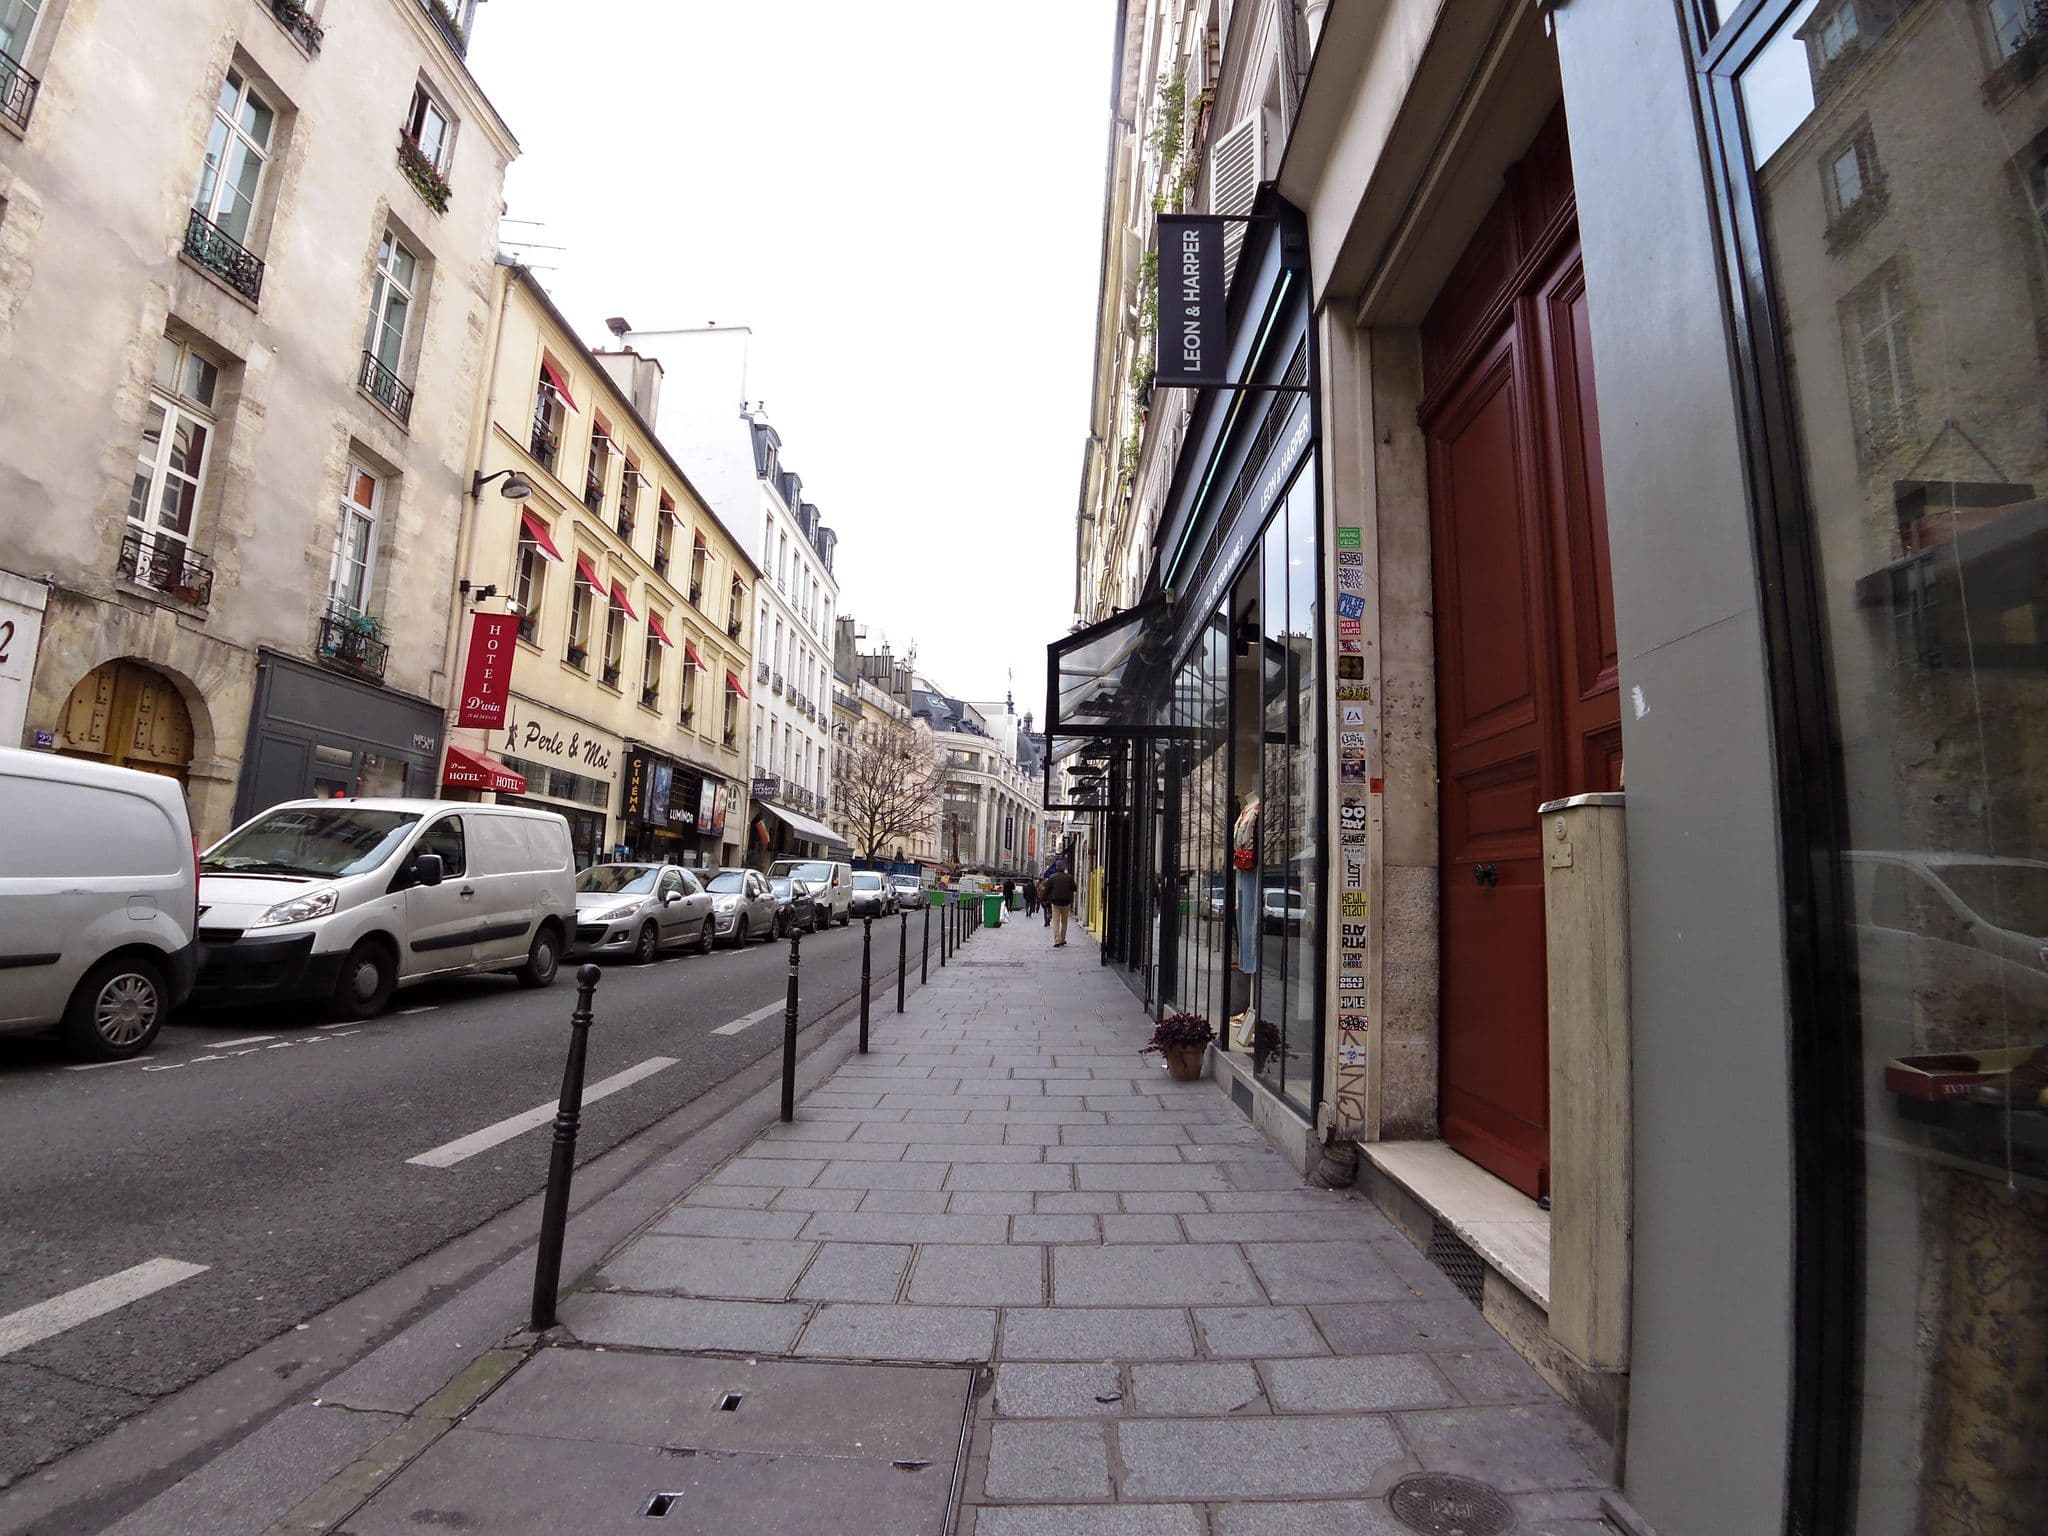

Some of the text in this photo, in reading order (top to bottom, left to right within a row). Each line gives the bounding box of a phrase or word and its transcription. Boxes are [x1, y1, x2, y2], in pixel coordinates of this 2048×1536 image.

[1183, 229, 1201, 372] LEON & HARPER
[1260, 472, 1277, 514] LEON
[1281, 413, 1309, 476] HARPER
[481, 624, 502, 694] HOTEL
[38, 733, 52, 746] 22
[523, 721, 563, 756] Perle
[568, 732, 579, 758] &
[449, 772, 480, 781] HOTEL
[495, 775, 519, 790] HOTEL
[629, 759, 642, 813] CINÉMA
